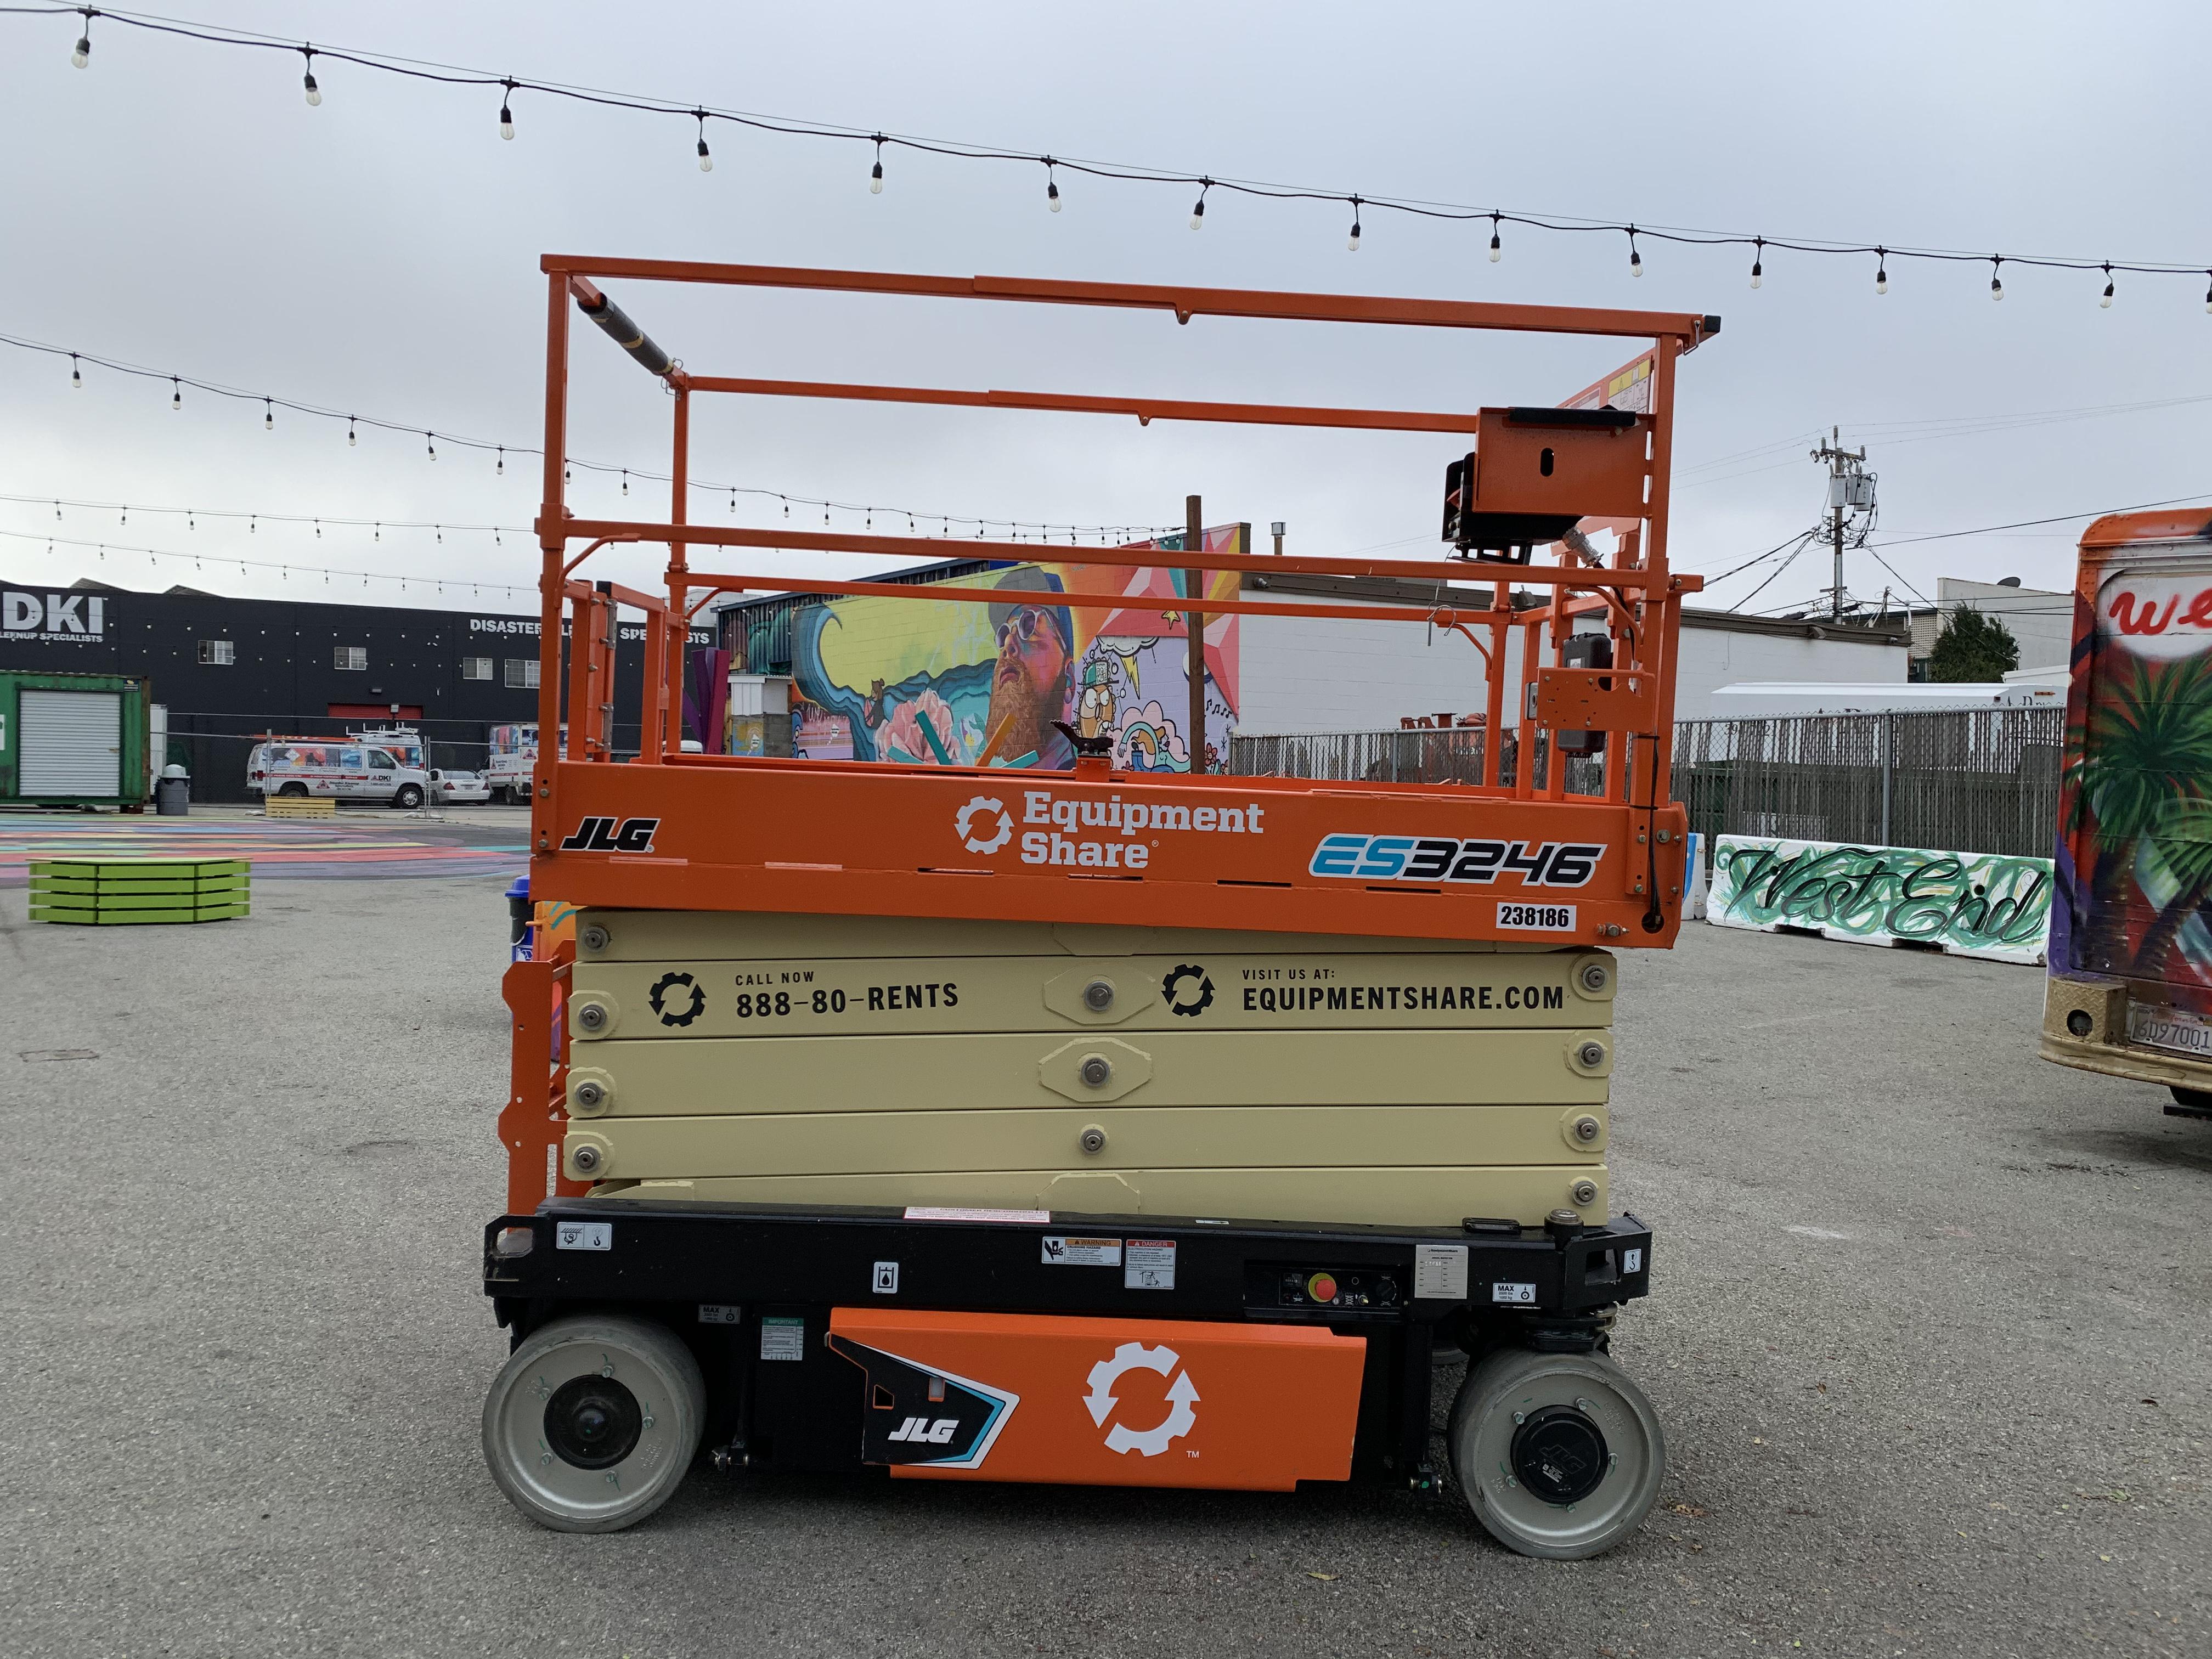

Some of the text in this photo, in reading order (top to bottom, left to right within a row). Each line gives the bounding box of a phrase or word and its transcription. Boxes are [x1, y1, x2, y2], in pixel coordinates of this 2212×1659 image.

[3, 592, 103, 634] DKI
[40, 633, 103, 642] SPECIALISTS
[1023, 791, 1264, 835] Equipment
[560, 816, 661, 852] JLG
[1021, 832, 1149, 868] Share
[1311, 834, 1604, 886] ES3246
[1724, 847, 2047, 943] West End
[1500, 906, 1570, 928] 238186
[736, 971, 814, 986] CALL NOW
[1242, 969, 1335, 980] VISIT US AT:
[1243, 986, 1563, 1013] EQUIPMENTSHARE.COM
[888, 1417, 960, 1443] JLG
